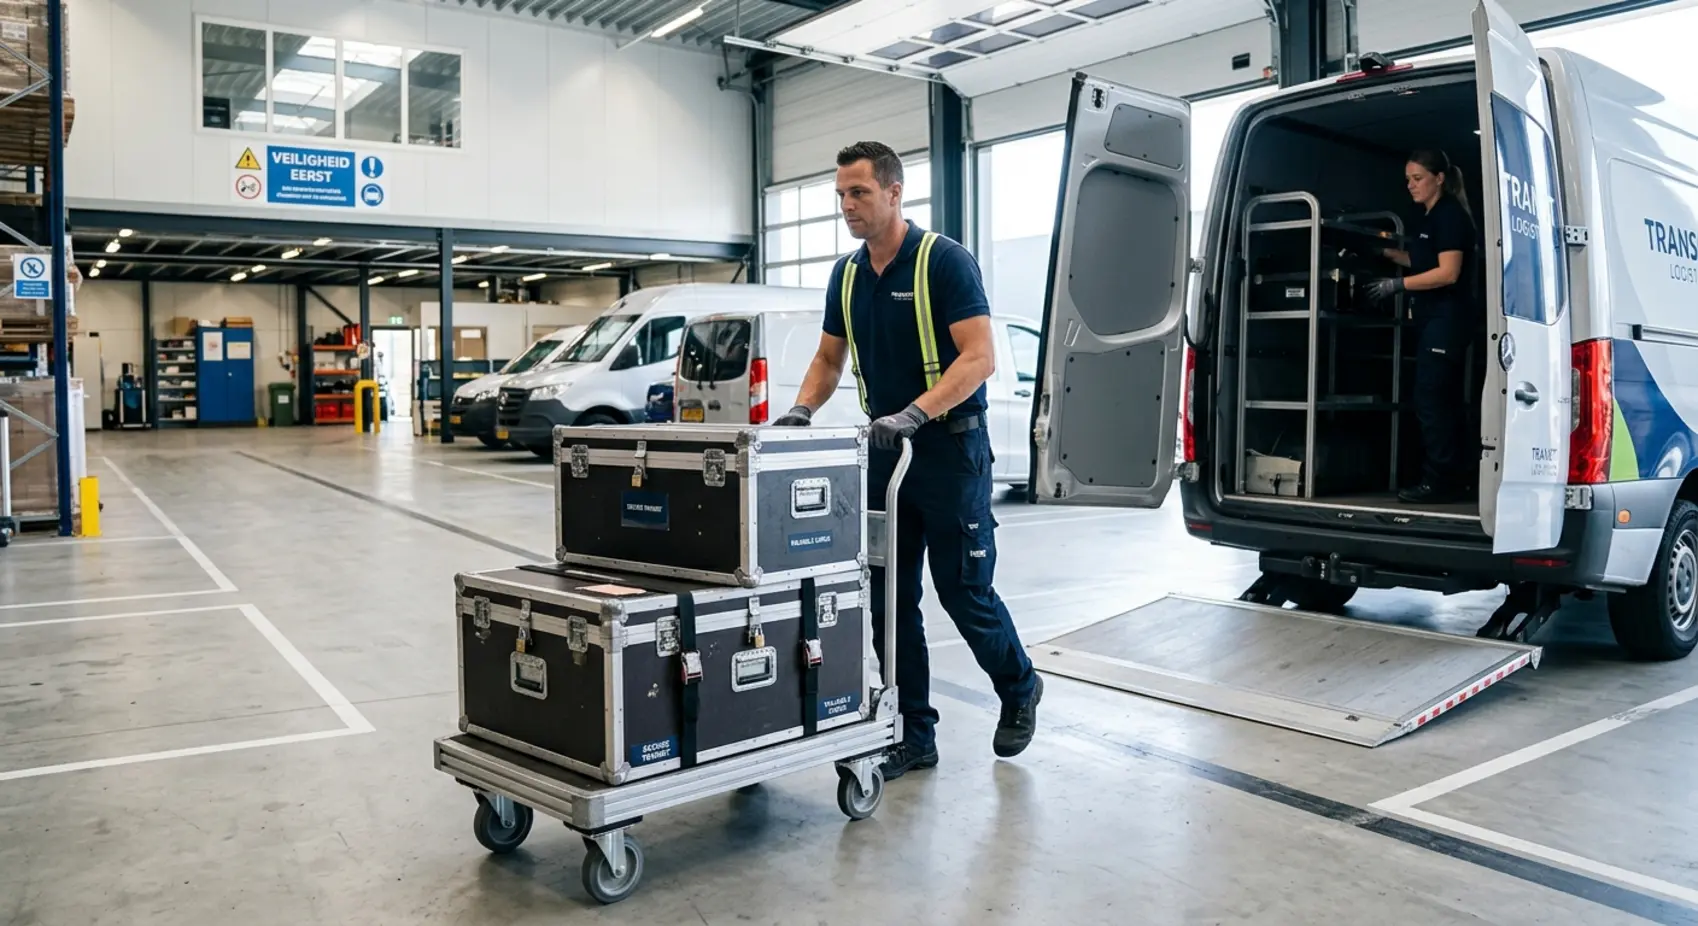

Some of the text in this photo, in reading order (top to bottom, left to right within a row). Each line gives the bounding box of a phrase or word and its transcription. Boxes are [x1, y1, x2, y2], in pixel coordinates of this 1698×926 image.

[271, 151, 350, 168] VEILIGHEID
[290, 169, 333, 183] EERST
[1644, 217, 1698, 261] TRANS
